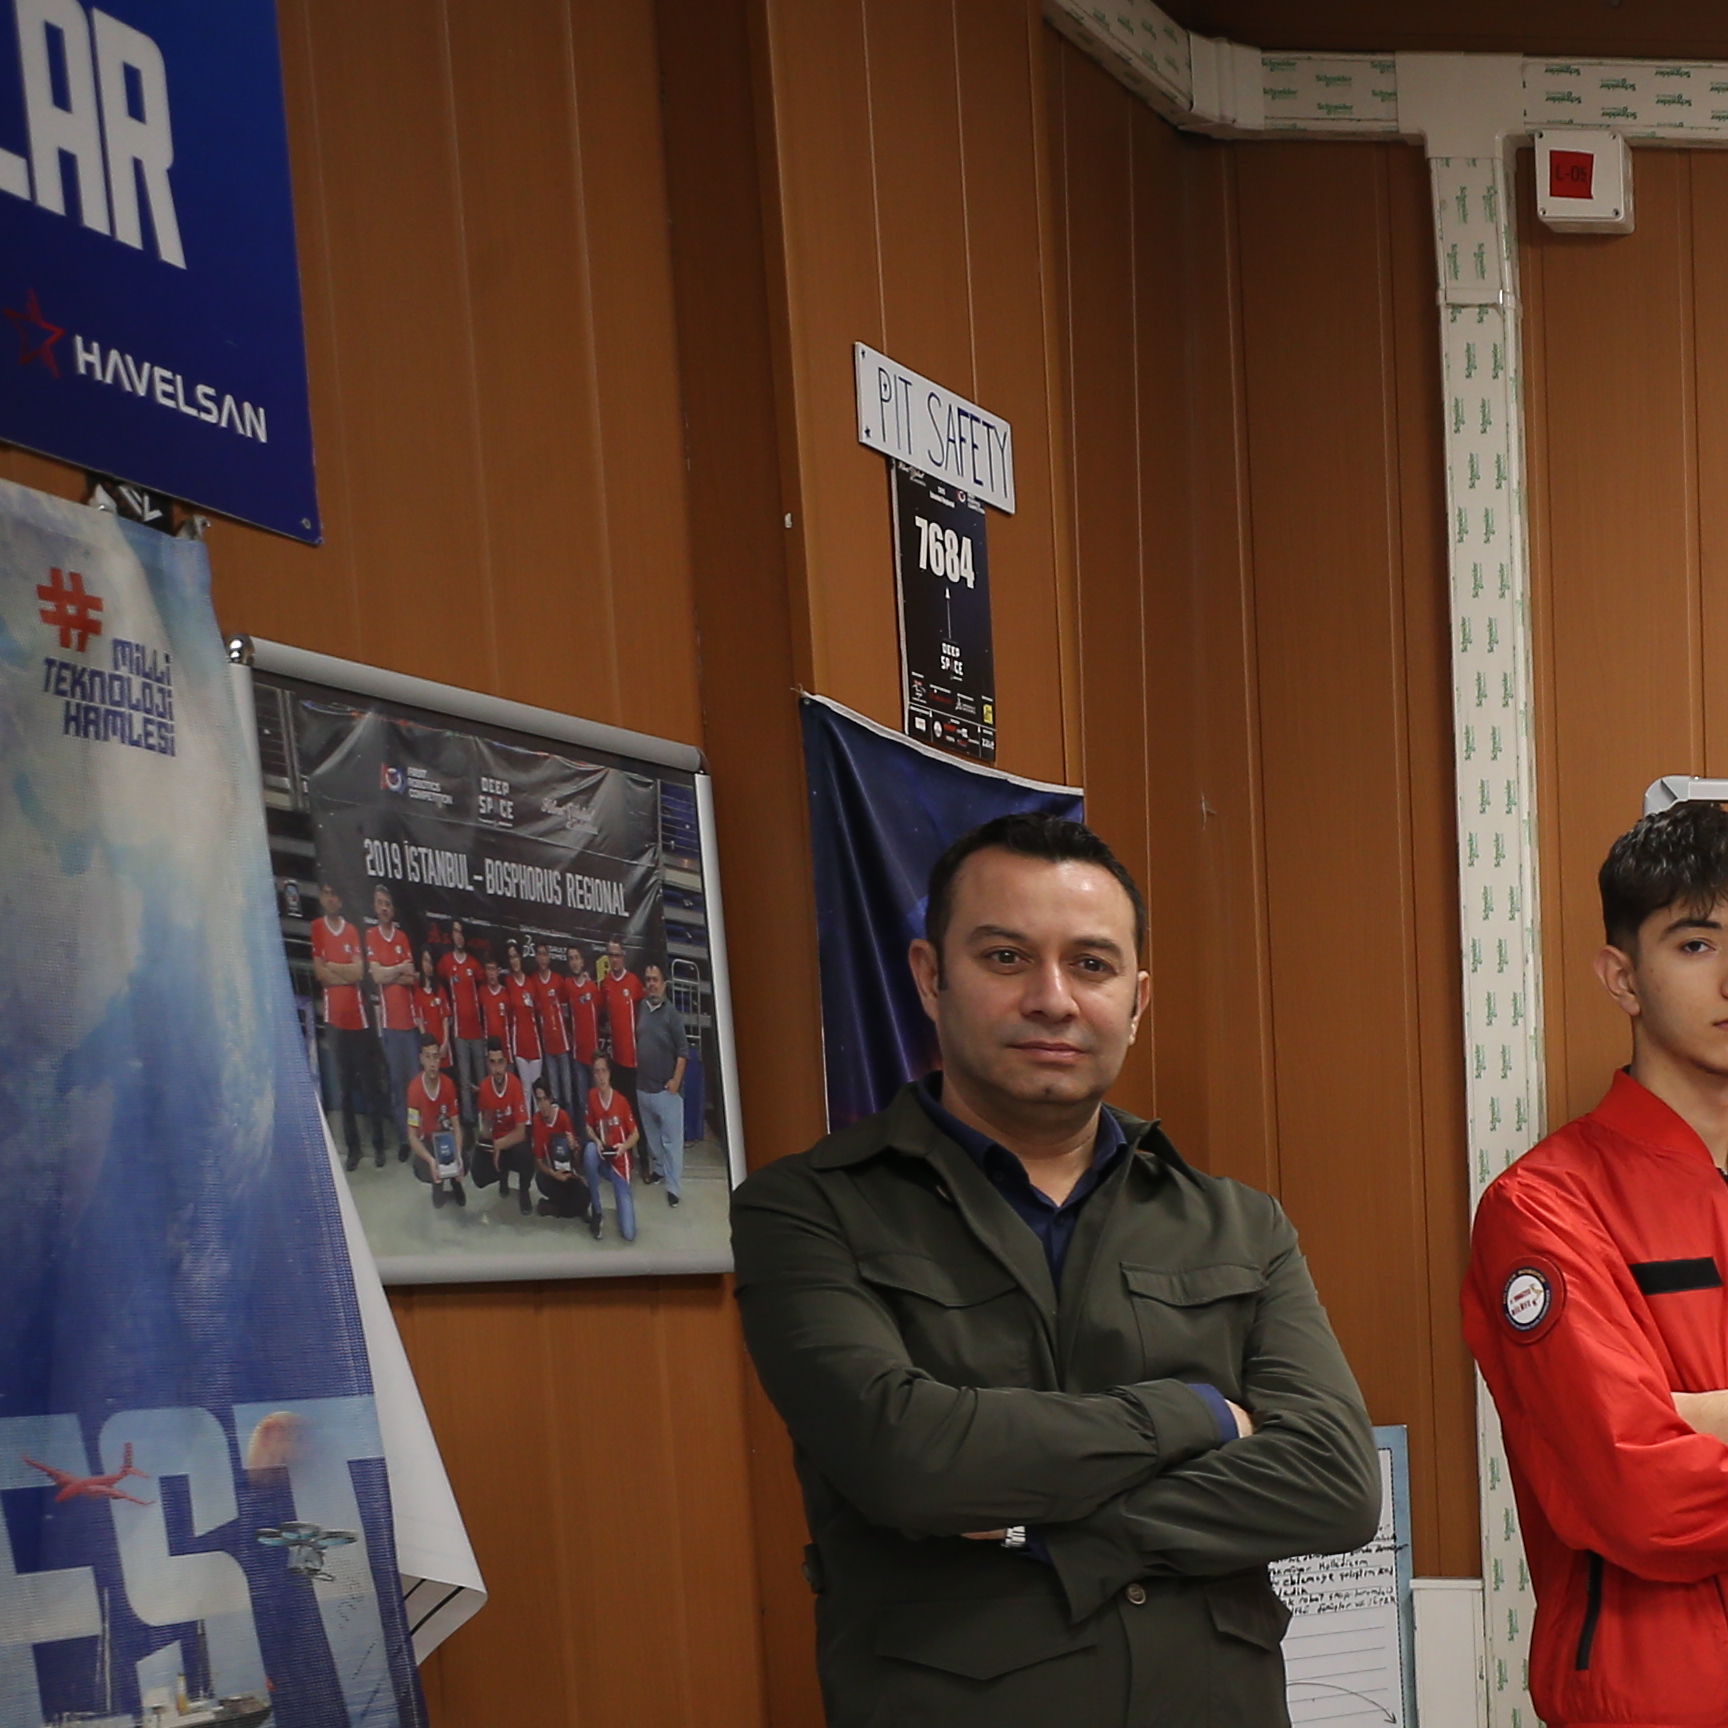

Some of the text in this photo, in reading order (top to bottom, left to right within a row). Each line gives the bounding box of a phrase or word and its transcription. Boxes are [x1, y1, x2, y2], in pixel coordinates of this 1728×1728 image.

[75, 334, 268, 443] HAVELSAN
[878, 366, 1008, 499] PIT SAFETY
[914, 515, 976, 589] 7684
[480, 776, 511, 795] DEEP
[364, 838, 403, 881] 2019
[485, 857, 563, 908] BOSPHORUS
[566, 872, 630, 918] REGIONAL
